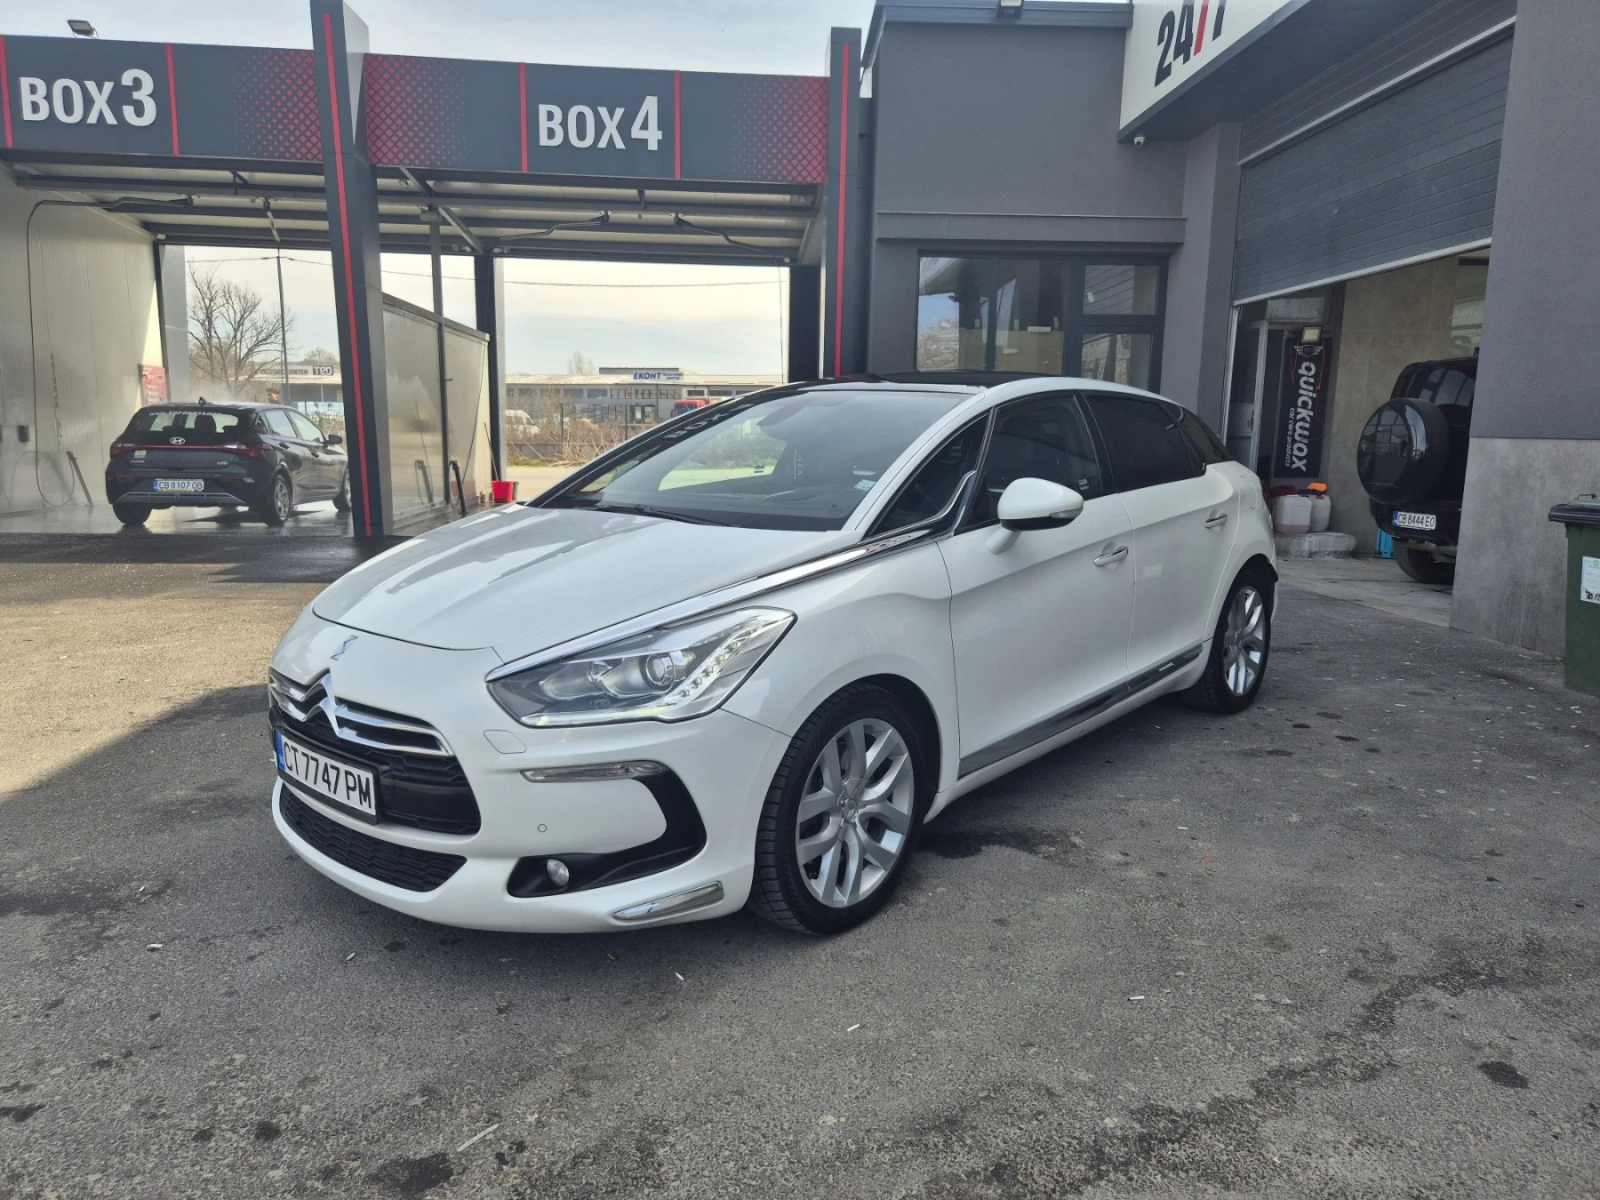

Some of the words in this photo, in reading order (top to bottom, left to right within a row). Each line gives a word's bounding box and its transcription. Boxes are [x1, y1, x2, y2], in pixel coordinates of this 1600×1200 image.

[538, 103, 626, 150] BOX
[631, 95, 663, 151] 4
[633, 371, 662, 380] ЕКОНТ
[1287, 420, 1295, 435] care
[1291, 361, 1317, 472] quickwax
[1284, 435, 1293, 468] products
[170, 481, 190, 489] 8107
[1398, 513, 1406, 524] CB
[1407, 514, 1424, 526] 8444
[284, 741, 299, 776] CT
[301, 751, 341, 795] 7747
[344, 769, 372, 809] PM
